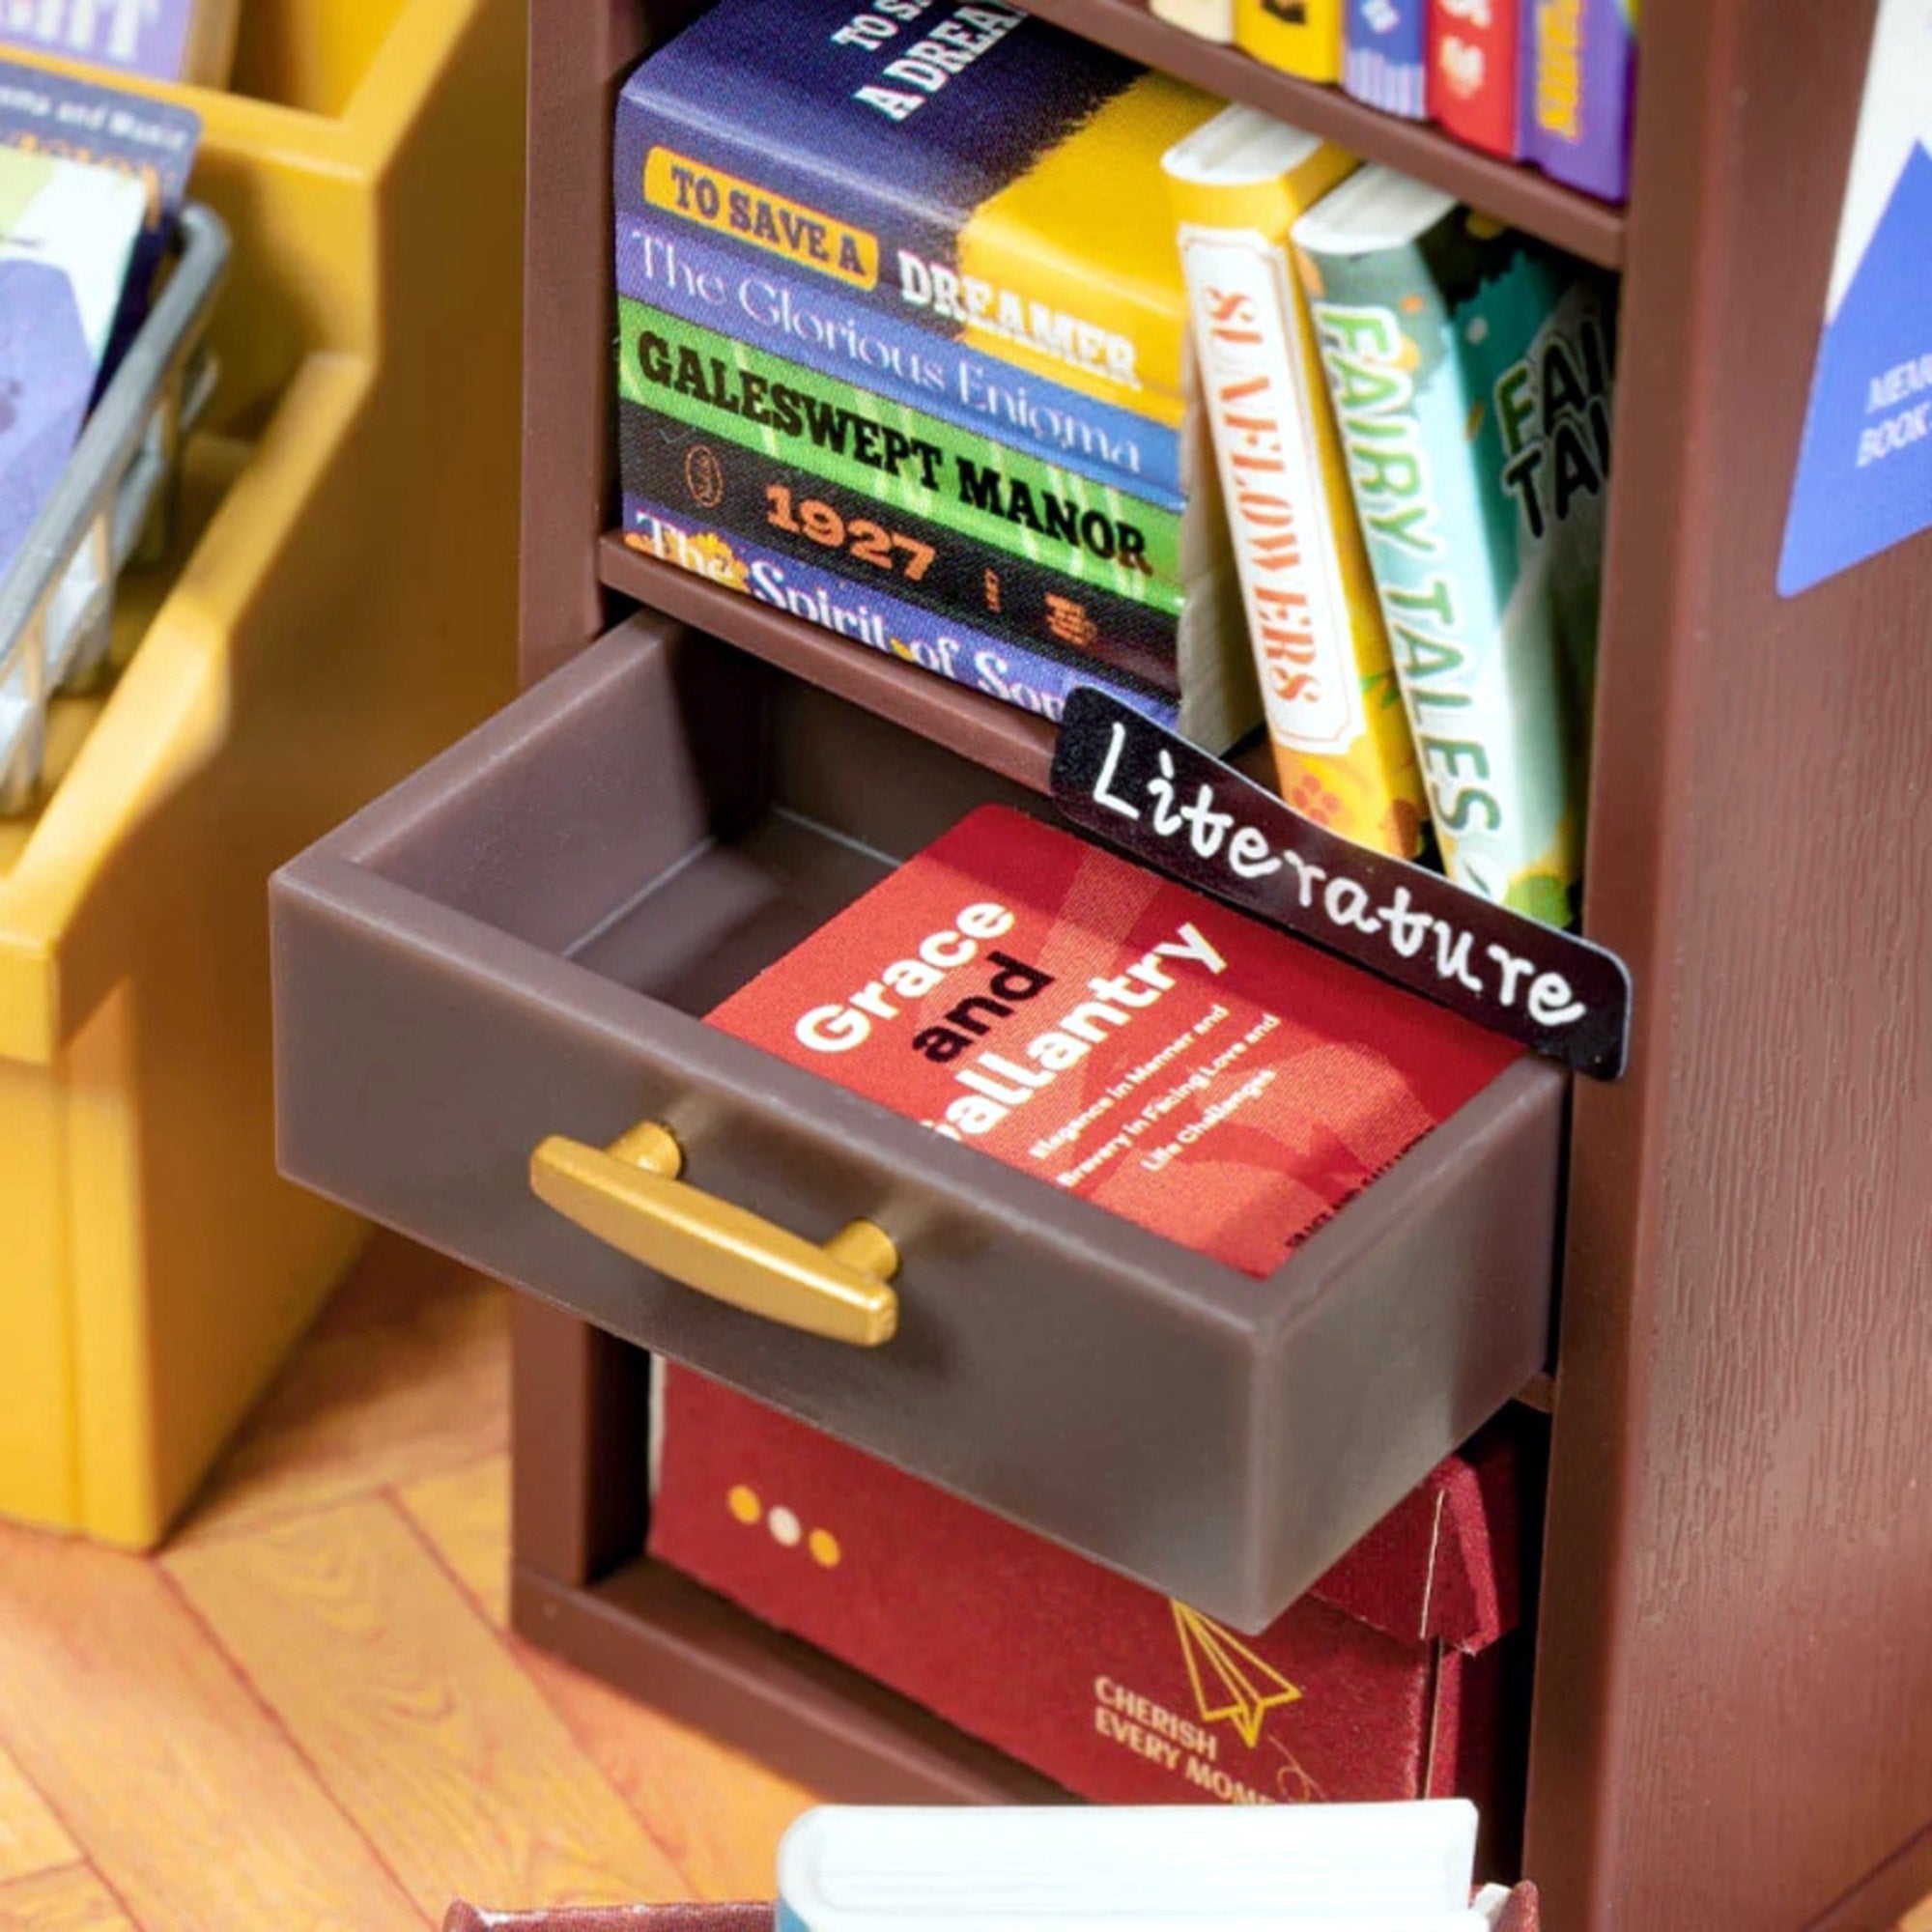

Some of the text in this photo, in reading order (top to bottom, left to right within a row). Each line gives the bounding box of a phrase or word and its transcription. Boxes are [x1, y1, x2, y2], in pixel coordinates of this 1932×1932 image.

[831, 14, 898, 50] TO
[852, 85, 926, 122] A
[670, 162, 867, 277] TO SAVE A
[632, 229, 1142, 474] The Glorious Enigma
[896, 249, 1143, 391] DREAMER
[1496, 320, 1616, 456] FAI
[637, 329, 945, 493] GALESWEPT
[954, 456, 1153, 578] MANOR
[636, 509, 734, 582] The
[750, 558, 892, 655] Spirit
[910, 637, 961, 677] of
[765, 483, 939, 582] 1927
[1319, 306, 1503, 832] FAIRY TALES
[1092, 721, 1587, 1026] Literature
[794, 901, 1016, 1054] Grace
[910, 951, 1058, 1065] and
[921, 922, 1229, 1143] allantry
[1028, 1003, 1231, 1161] Elegance in Manner and
[1056, 1011, 1282, 1188] Bravery in Facing Love and
[1139, 1068, 1278, 1173] Life Challenges
[1094, 1674, 1219, 1763] CHERISH
[1094, 1705, 1181, 1772] EVERY
